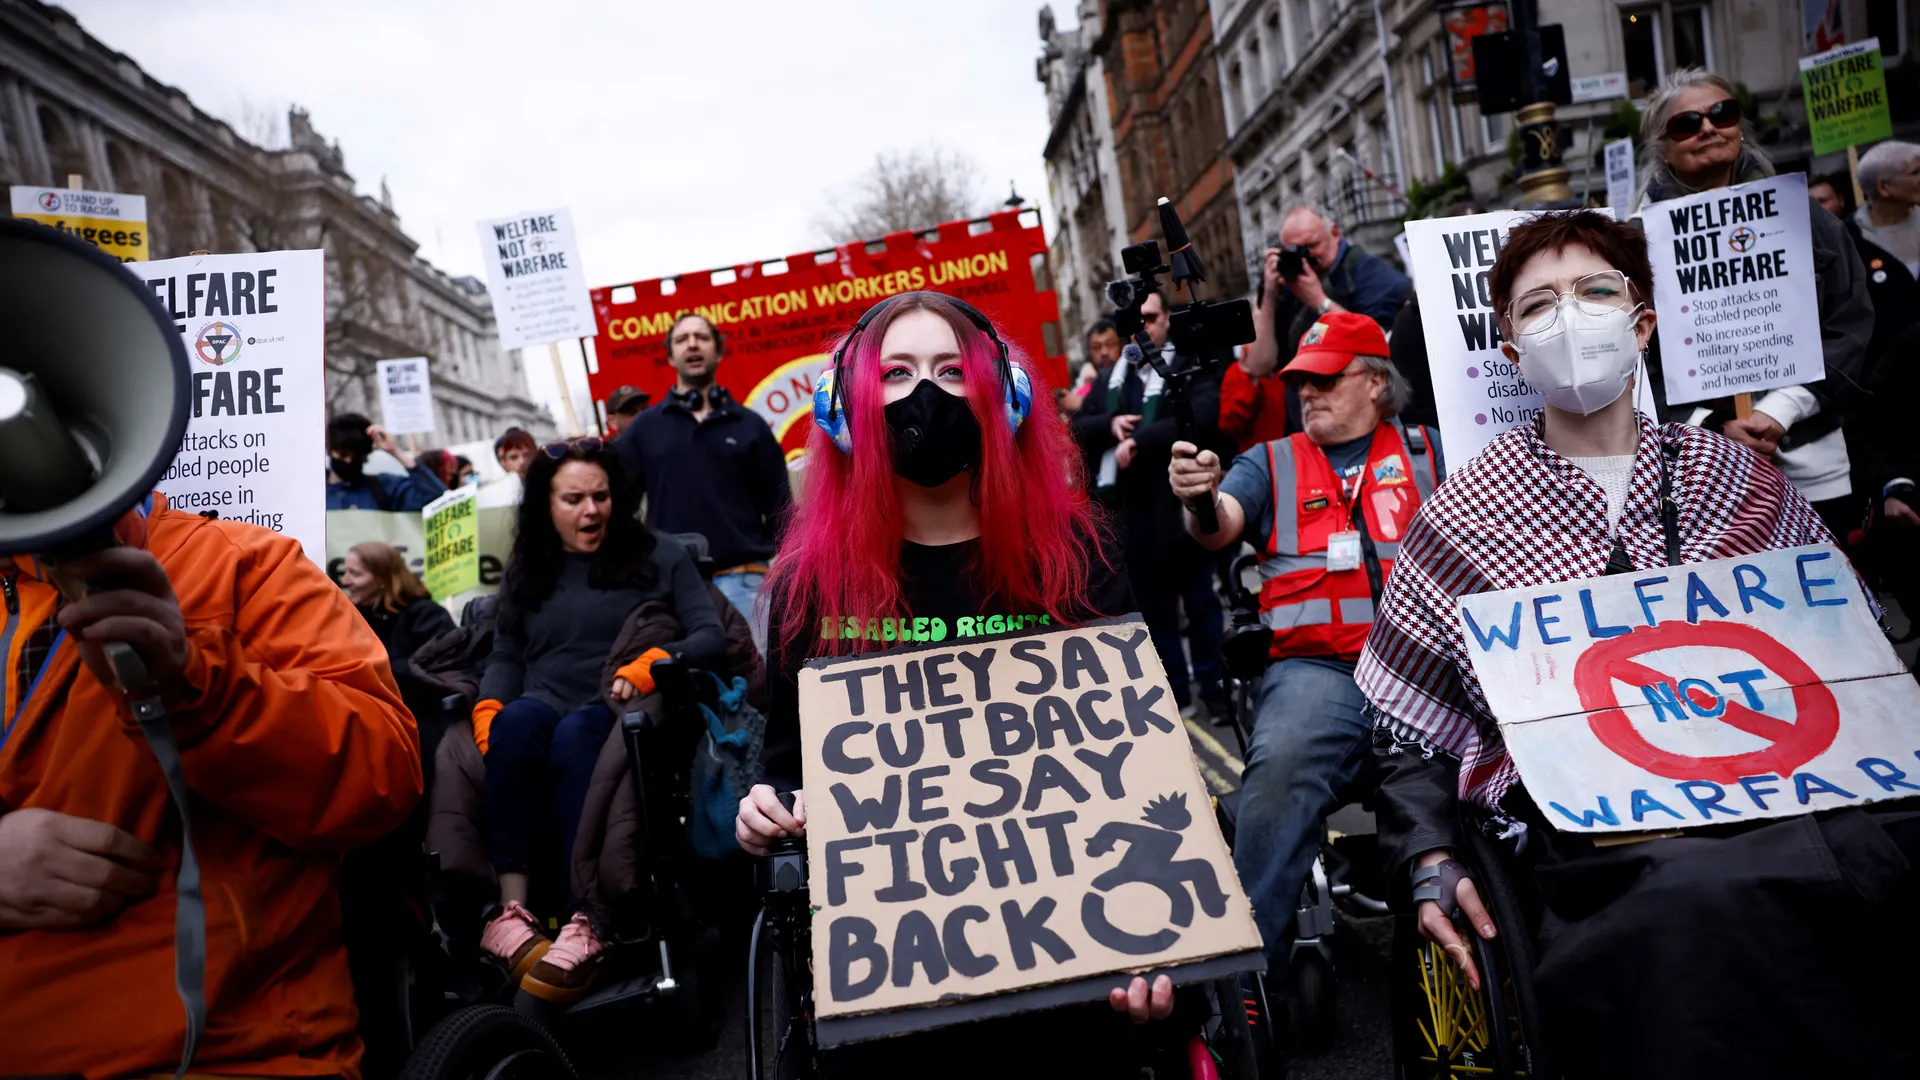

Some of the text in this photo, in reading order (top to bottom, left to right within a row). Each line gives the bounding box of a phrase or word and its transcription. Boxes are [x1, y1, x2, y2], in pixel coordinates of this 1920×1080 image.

[1806, 53, 1876, 87] WELFARE
[1810, 82, 1840, 102] NOT
[1813, 88, 1882, 122] WARFARE
[62, 193, 96, 204] STAND
[64, 203, 119, 216] TO RACISM
[1669, 189, 1779, 235] WELFARE
[40, 220, 142, 247] fugees
[493, 215, 558, 240] WELFARE
[498, 240, 525, 260] NOT
[1673, 231, 1721, 266] NOT
[502, 252, 568, 278] WARFARE
[812, 267, 925, 307] WORKERS
[929, 250, 1009, 286] UNION
[1676, 249, 1788, 295] WARFARE
[141, 269, 278, 321] ELFARE
[1451, 271, 1492, 310] NO
[1692, 288, 1778, 313] Stop attacks on
[1694, 302, 1782, 327] disabled people
[1696, 321, 1775, 344] No increase in
[1698, 333, 1794, 359] military spending
[1700, 354, 1779, 376] Social security
[1701, 363, 1796, 390] and homes for all
[192, 368, 285, 418] FARE
[1488, 381, 1540, 398] disabl
[1492, 407, 1514, 424] No
[243, 432, 265, 448] on
[207, 452, 270, 480] people
[164, 485, 254, 511] ncrease in
[426, 500, 472, 532] WELFARE
[427, 529, 445, 550] NOT
[427, 536, 475, 570] WARFARE
[1462, 552, 1848, 652] WELFARE
[820, 629, 1148, 716] THEY SAY
[1641, 669, 1767, 722] NOT
[822, 685, 1175, 774] CUT BACK
[830, 742, 1134, 833] WE SAY
[1549, 750, 1920, 828] WARFAR
[826, 810, 1077, 907] FIGHT
[829, 897, 1076, 1002] BACK
